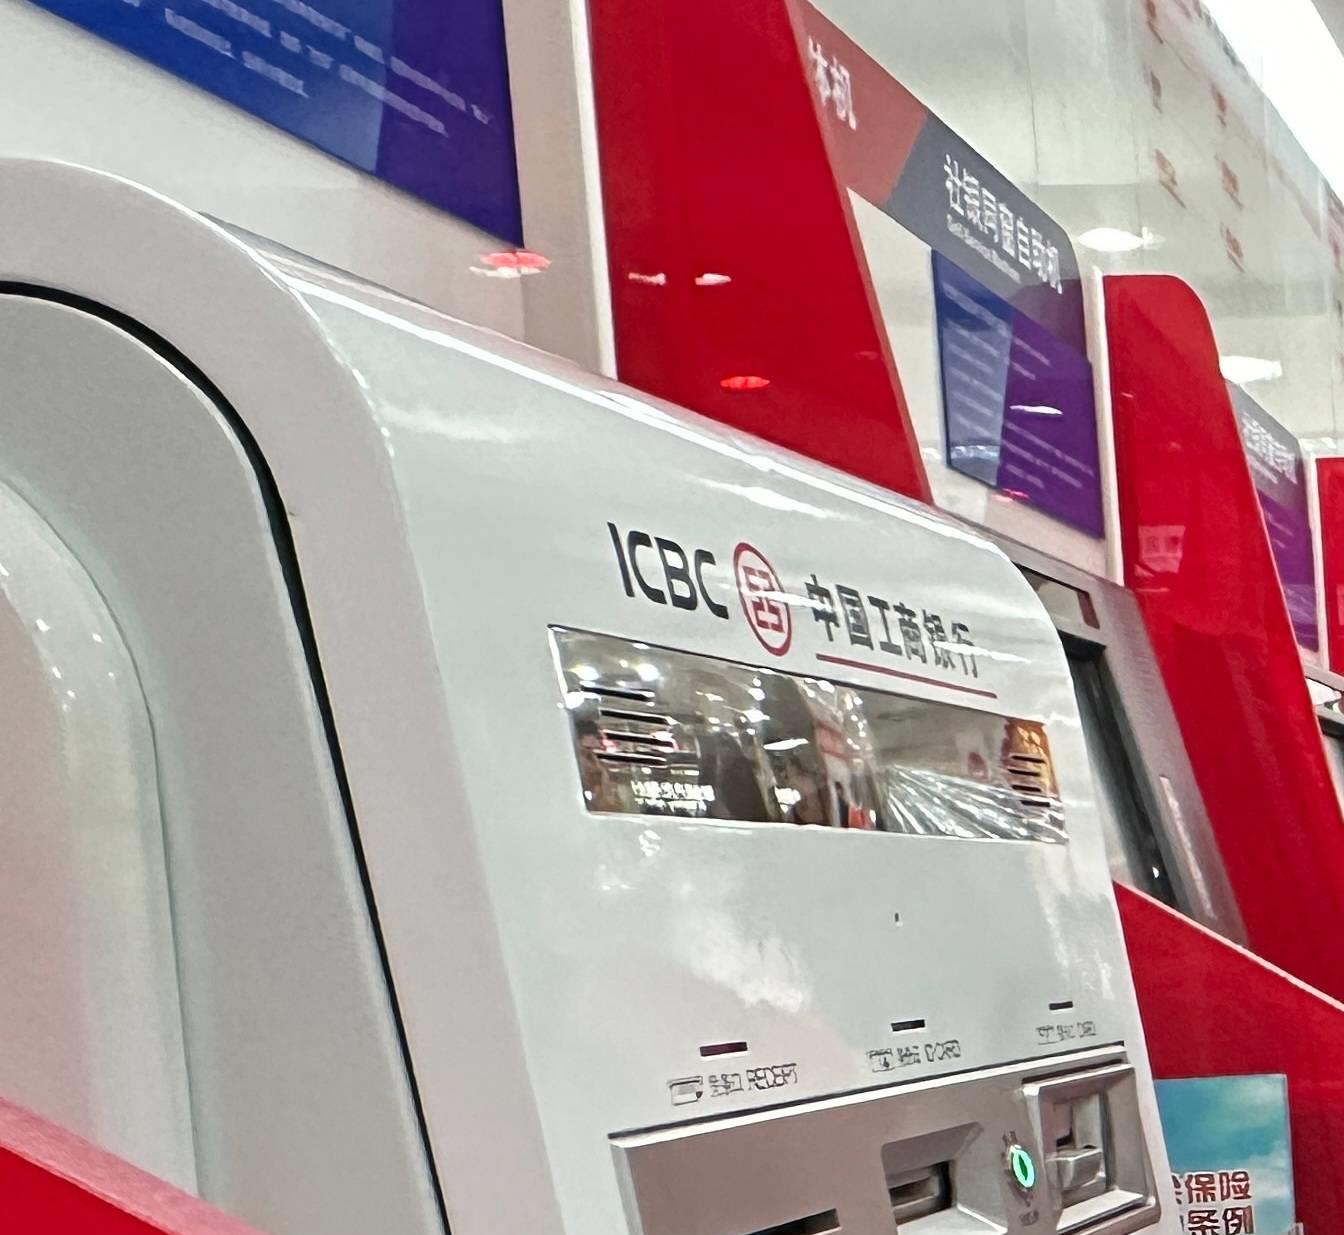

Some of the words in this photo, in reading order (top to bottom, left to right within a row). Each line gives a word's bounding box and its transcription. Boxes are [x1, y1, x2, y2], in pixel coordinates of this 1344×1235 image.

[606, 521, 729, 620] ICBC
[804, 573, 979, 678] 中国工商银行
